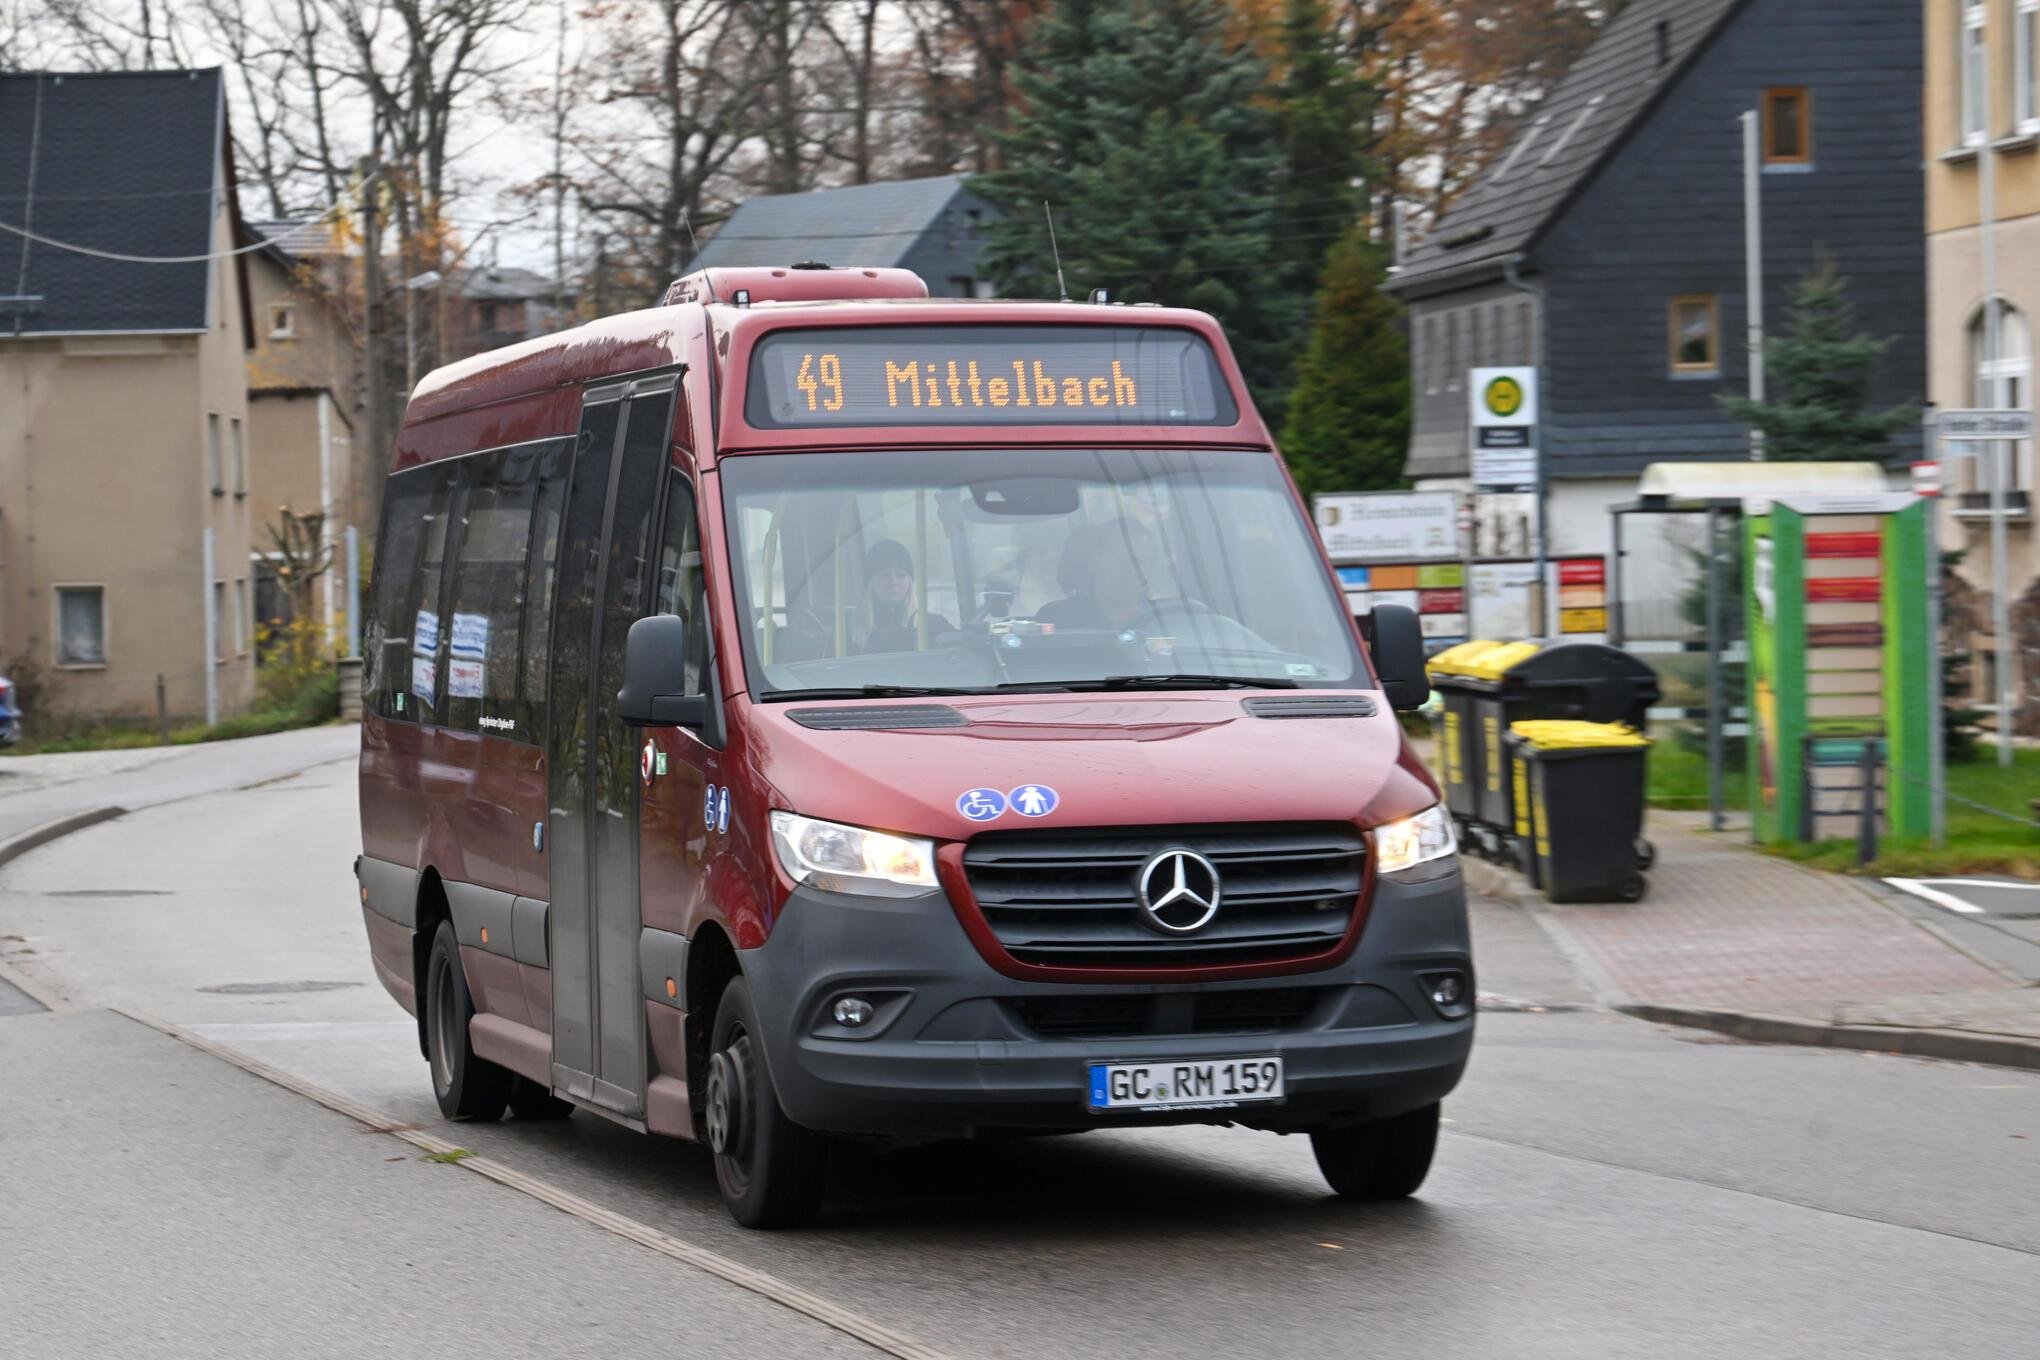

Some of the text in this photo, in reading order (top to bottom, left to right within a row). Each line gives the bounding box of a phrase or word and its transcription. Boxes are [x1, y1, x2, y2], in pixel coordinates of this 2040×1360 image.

[797, 354, 1137, 411] 49 Mittelbach
[1111, 1068, 1150, 1100] GC
[1174, 1065, 1214, 1097] RM
[1222, 1062, 1278, 1095] 159
